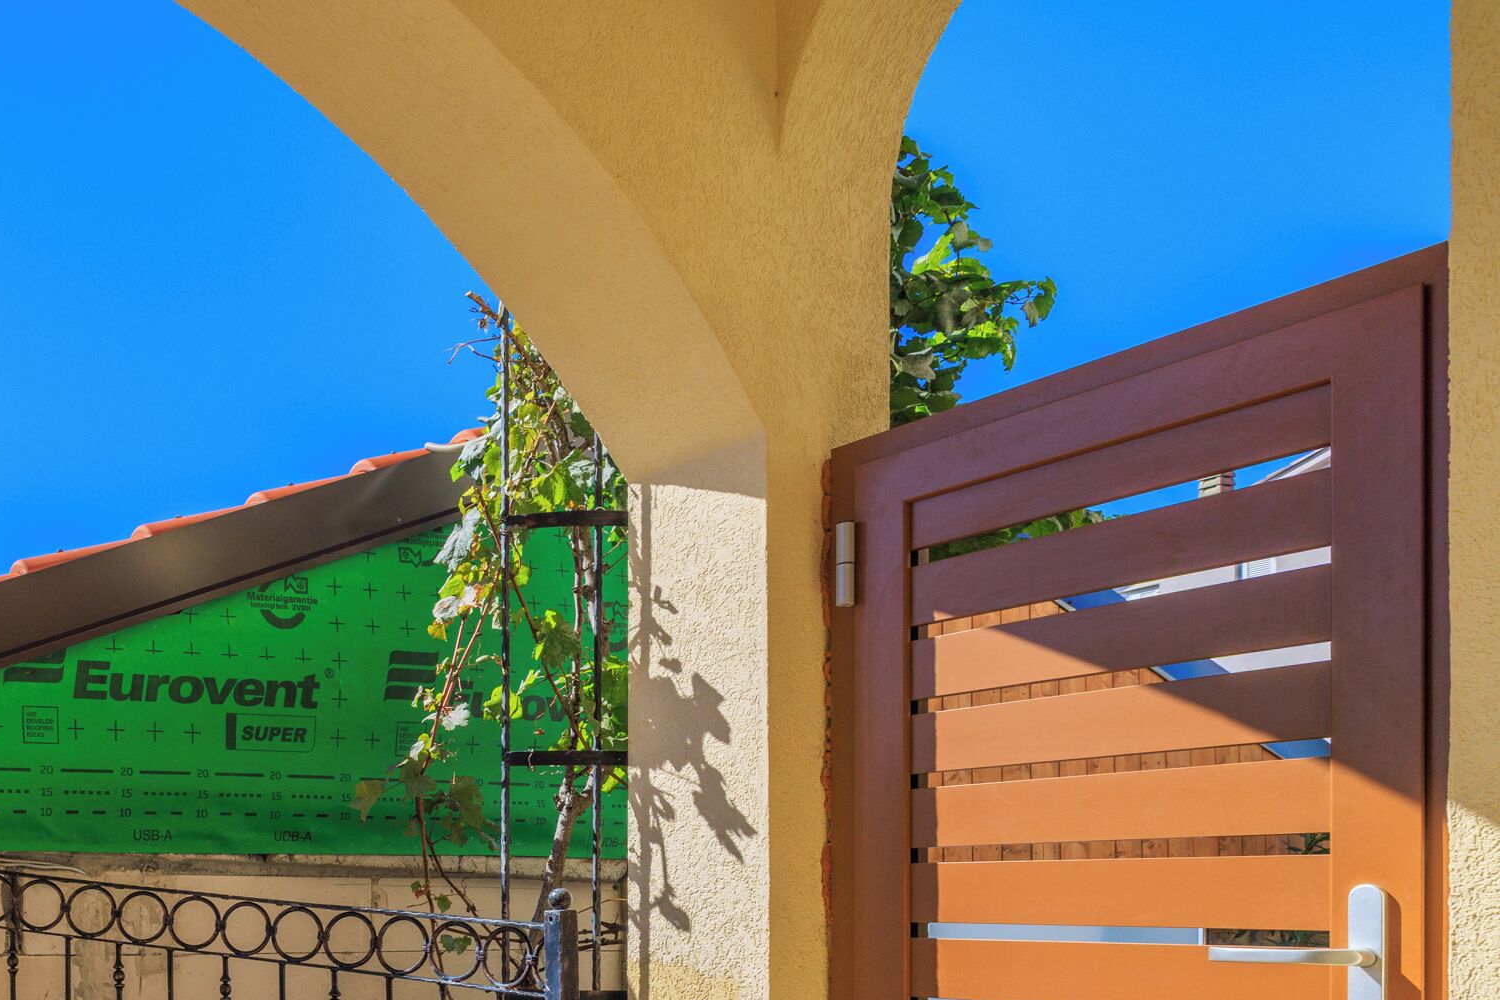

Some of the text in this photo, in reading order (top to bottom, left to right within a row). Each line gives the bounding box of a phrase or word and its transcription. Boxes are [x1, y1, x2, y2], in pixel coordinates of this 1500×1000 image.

[247, 592, 318, 605] Materialgarantie
[73, 659, 320, 709] Eurovent
[241, 725, 308, 743] SUPER
[40, 765, 54, 775] 20
[120, 767, 134, 777] 20
[197, 769, 209, 779] 20
[269, 771, 282, 781] 20
[339, 773, 351, 783] 20
[534, 780, 545, 790] 20
[40, 788, 53, 798] 15
[120, 789, 133, 799] 15
[197, 790, 209, 800] 15
[270, 792, 282, 802] 15
[341, 793, 352, 803] 15
[536, 799, 546, 809] 15
[40, 807, 53, 817] 10
[119, 808, 132, 818] 10
[196, 809, 208, 819] 10
[269, 811, 281, 820] 10
[339, 812, 351, 821] 10
[534, 817, 546, 827] 10
[133, 829, 173, 842] USB-A
[274, 830, 313, 843] UDB-A
